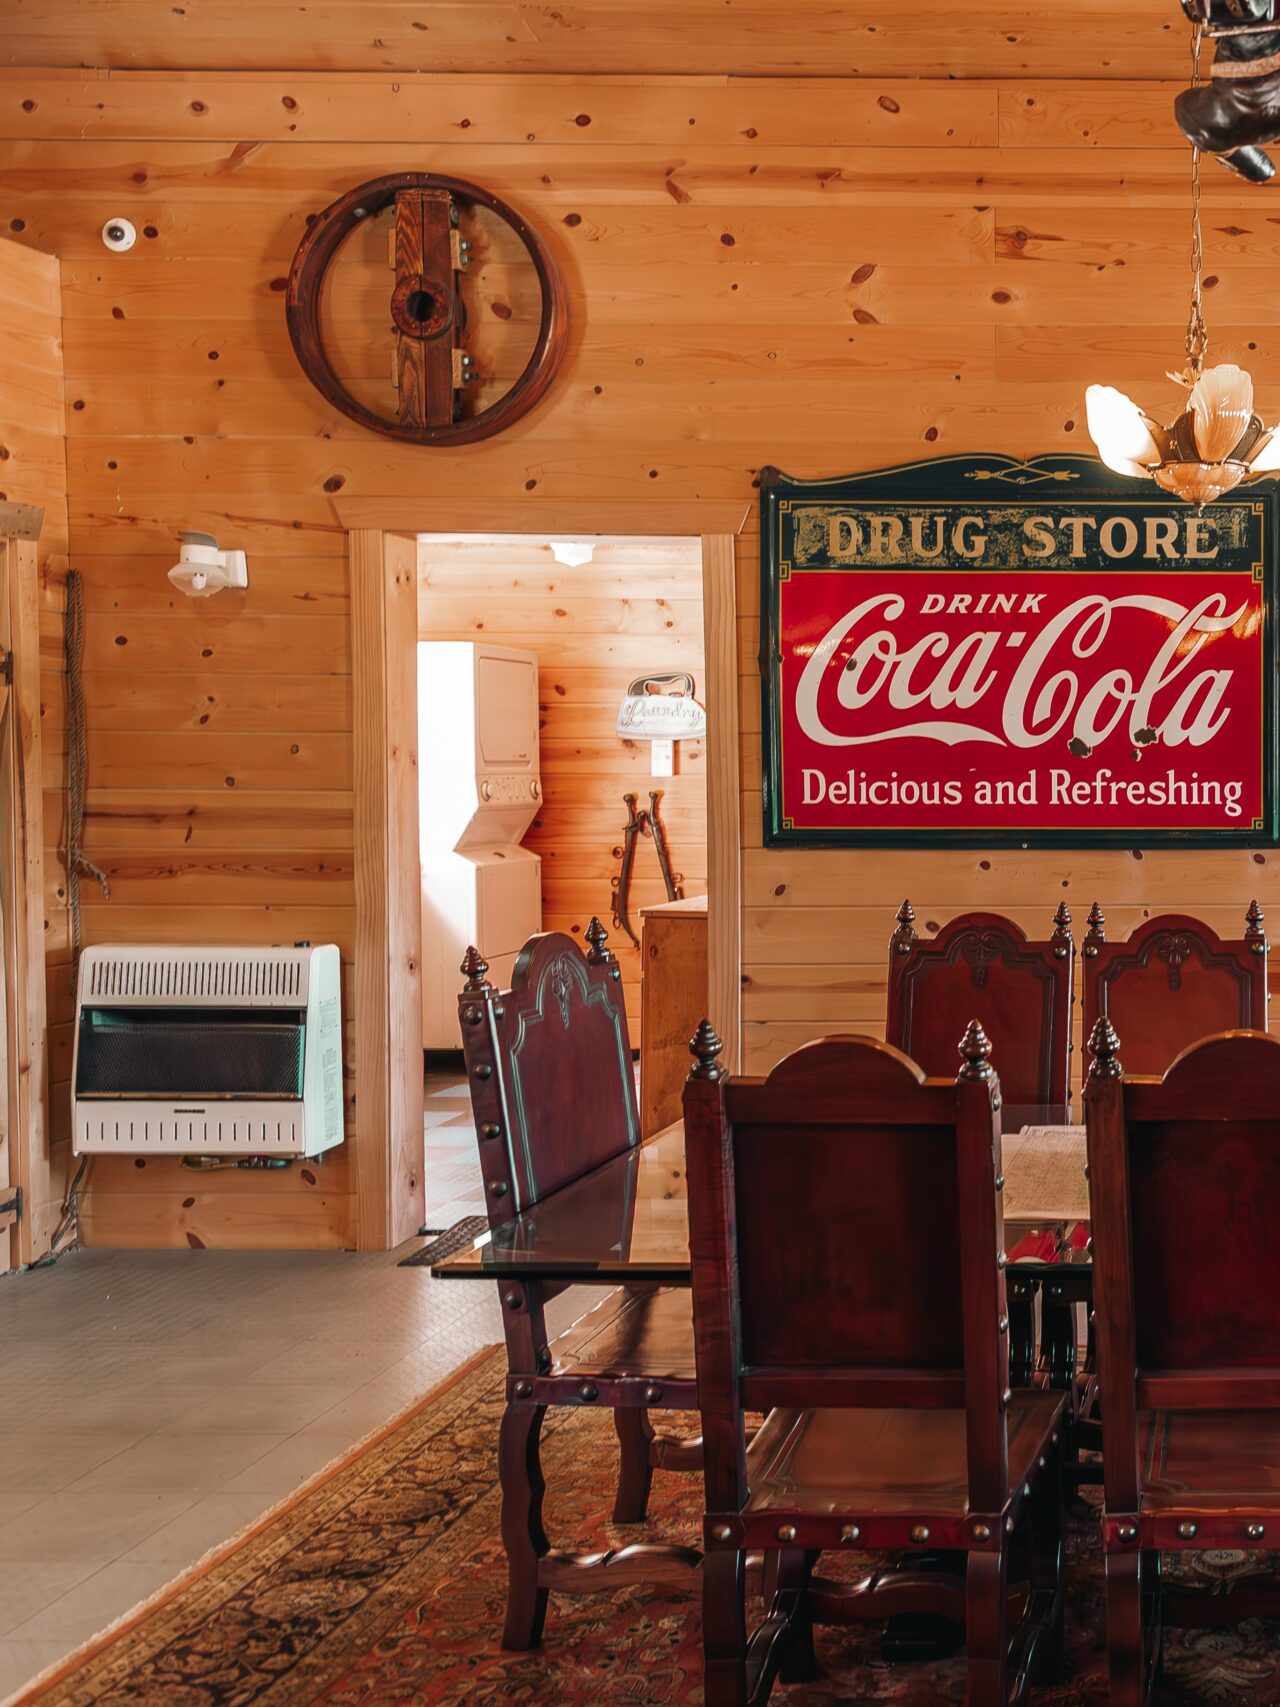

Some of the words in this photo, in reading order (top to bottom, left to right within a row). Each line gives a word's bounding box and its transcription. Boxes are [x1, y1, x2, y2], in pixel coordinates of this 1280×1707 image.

[828, 515, 988, 558] DRUG
[1021, 516, 1220, 559] STORE
[919, 594, 1048, 614] DRINK
[795, 592, 1249, 748] Coca-Cola
[621, 699, 703, 728] Laundry
[801, 768, 963, 806] Delicious
[974, 768, 1037, 806] and
[1049, 768, 1243, 817] Refreshing
